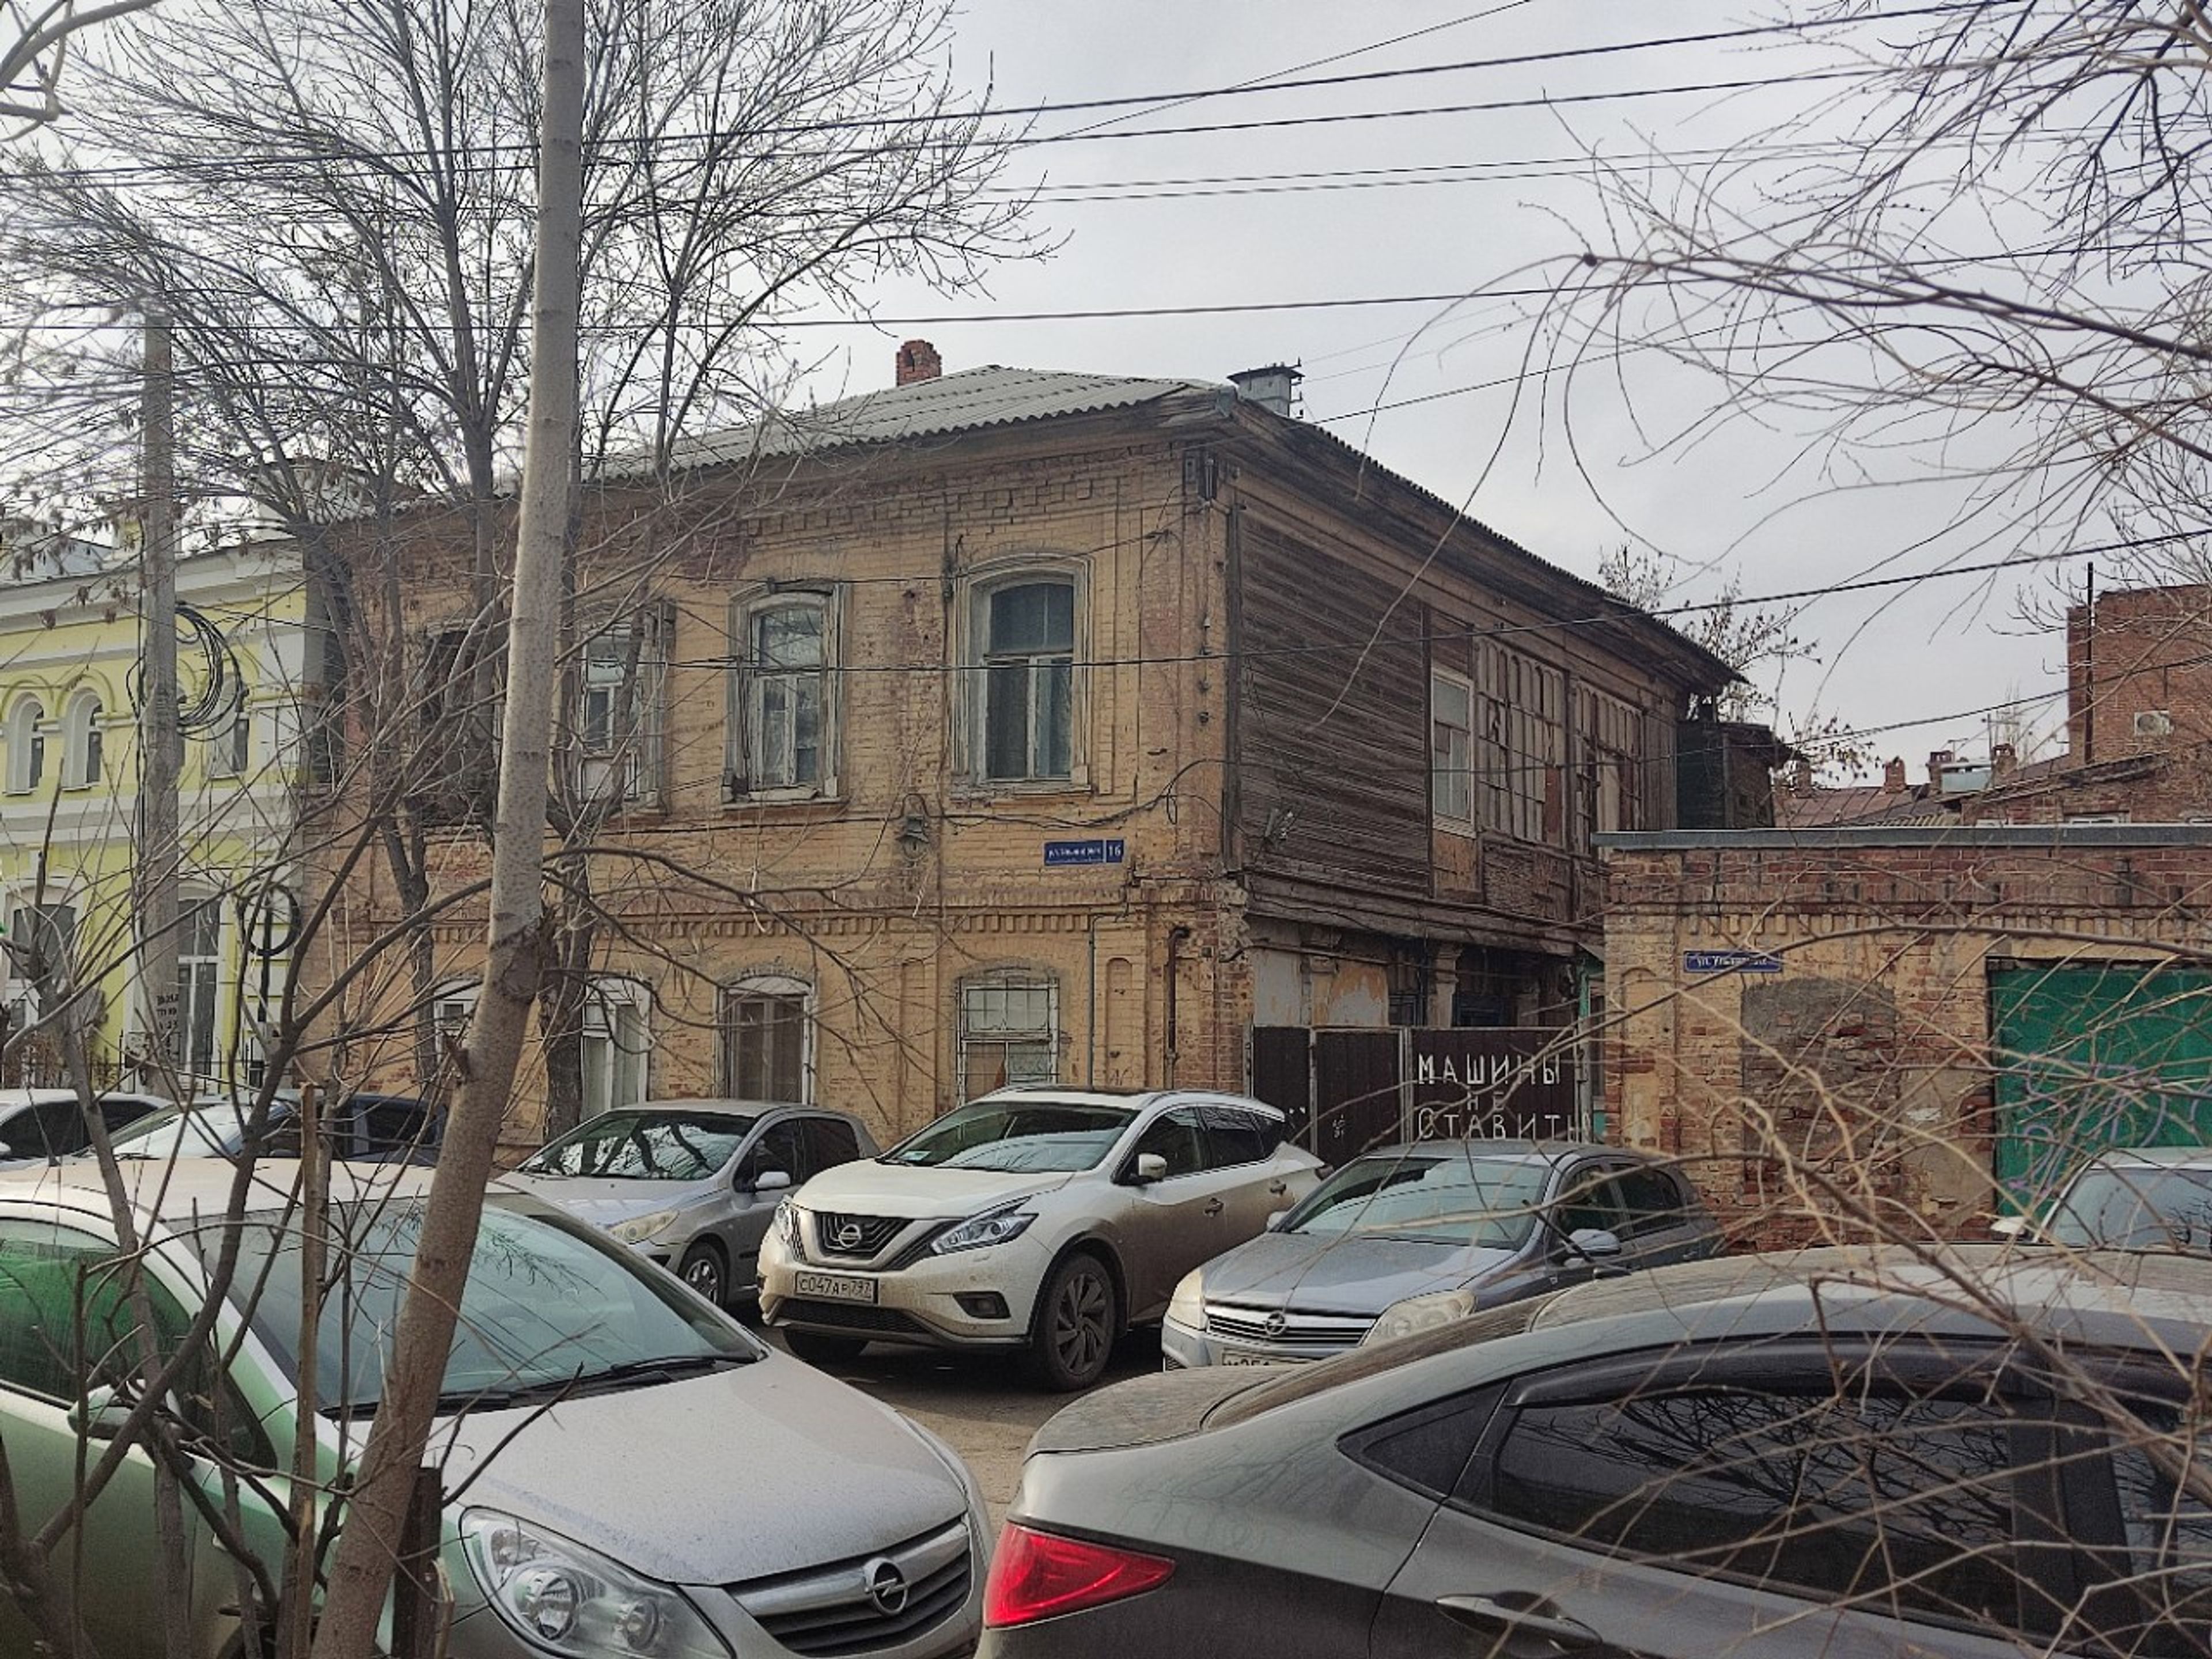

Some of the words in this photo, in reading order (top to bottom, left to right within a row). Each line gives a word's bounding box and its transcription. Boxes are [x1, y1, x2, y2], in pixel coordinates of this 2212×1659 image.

[1108, 844, 1121, 857] 16
[1418, 1053, 1560, 1085] МАШИНЫ
[1467, 1091, 1504, 1111] НЕ
